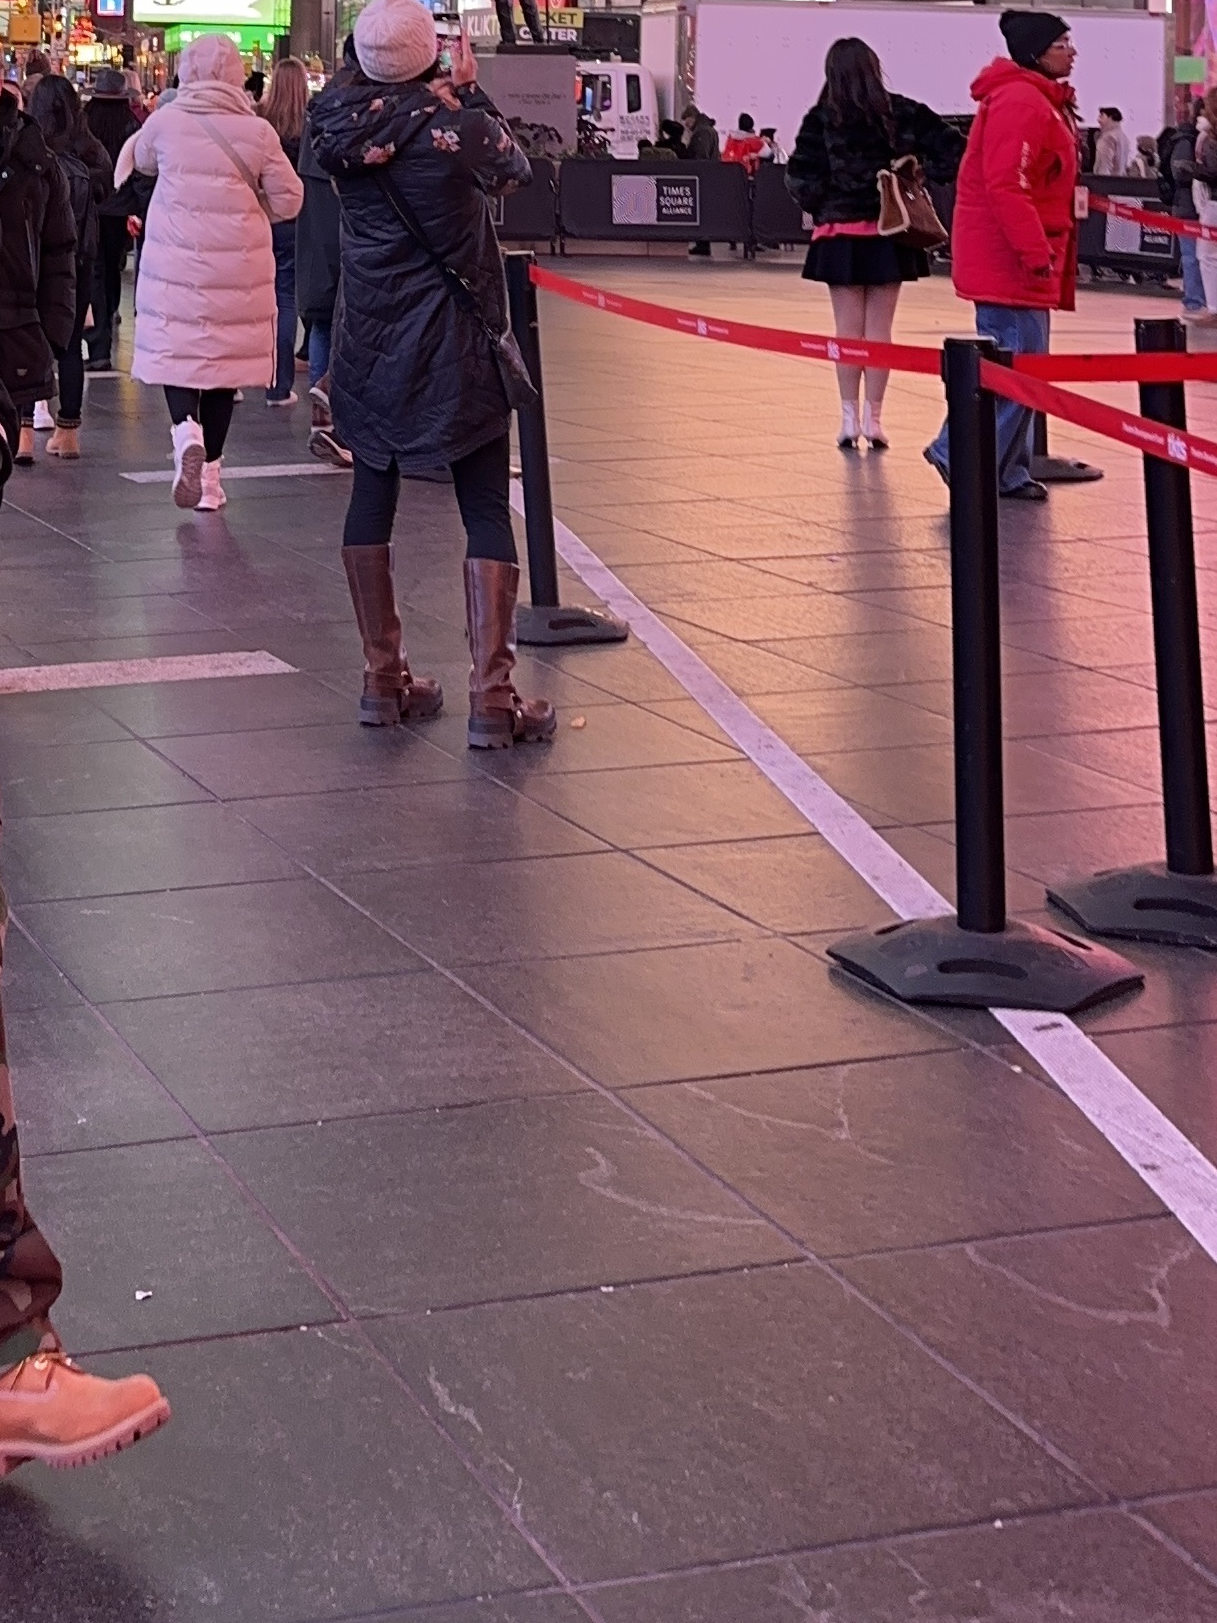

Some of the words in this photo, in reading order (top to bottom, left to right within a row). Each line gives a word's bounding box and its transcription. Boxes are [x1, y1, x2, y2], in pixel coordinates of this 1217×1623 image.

[539, 11, 577, 25] CKET
[519, 26, 577, 42] CTER
[663, 186, 691, 196] TIMES
[659, 196, 694, 207] SQUARE
[662, 207, 693, 215] ALLIANCE
